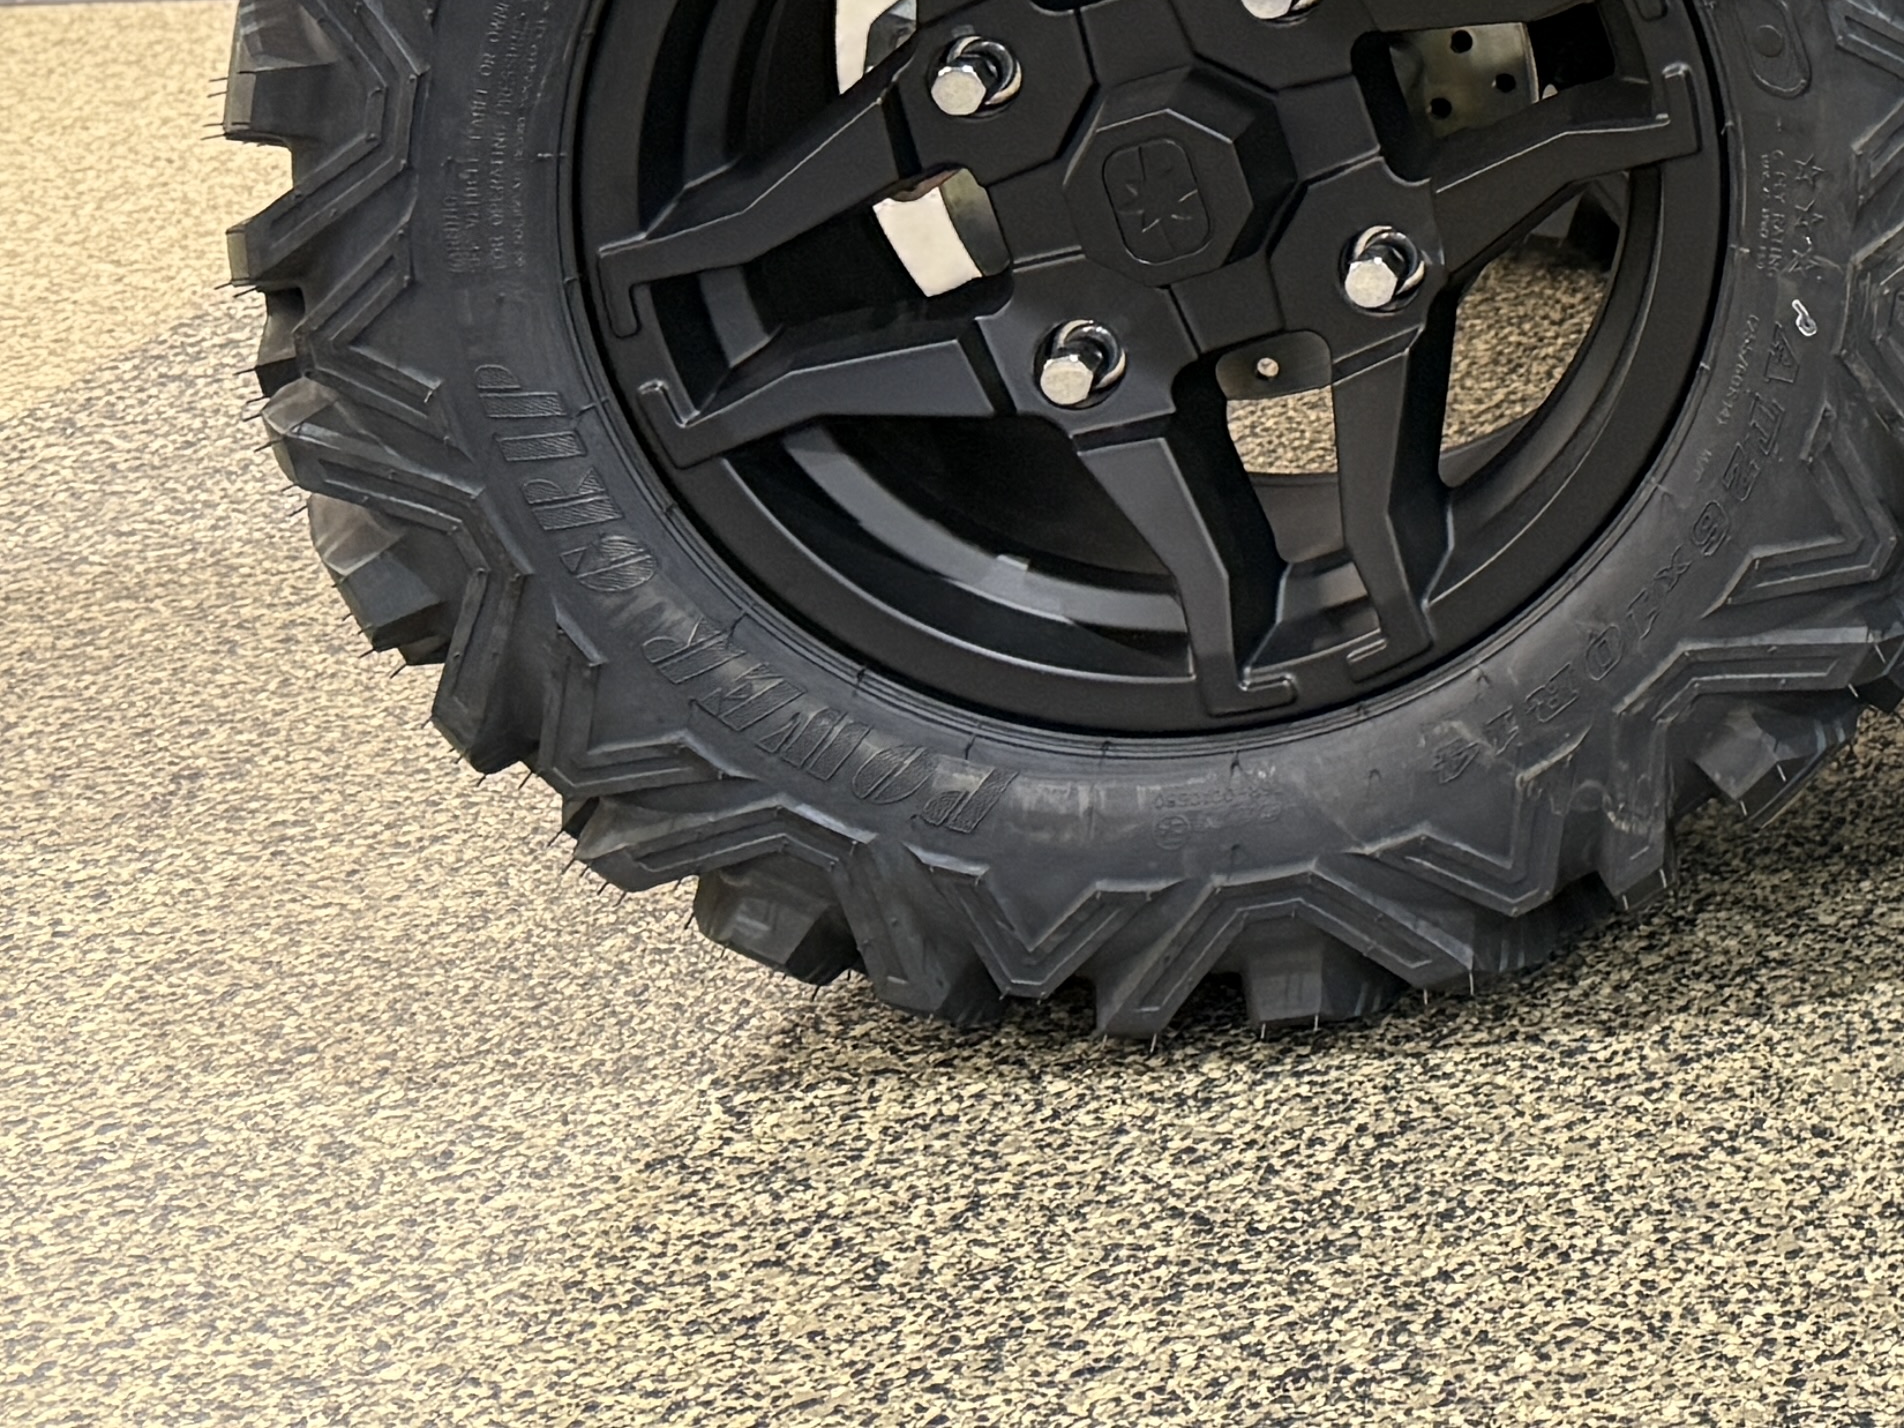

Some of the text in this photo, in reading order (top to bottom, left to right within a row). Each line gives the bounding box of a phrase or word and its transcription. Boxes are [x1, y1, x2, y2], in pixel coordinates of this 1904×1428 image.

[478, 51, 497, 78] OR
[473, 363, 1020, 836] POWER GRIP
